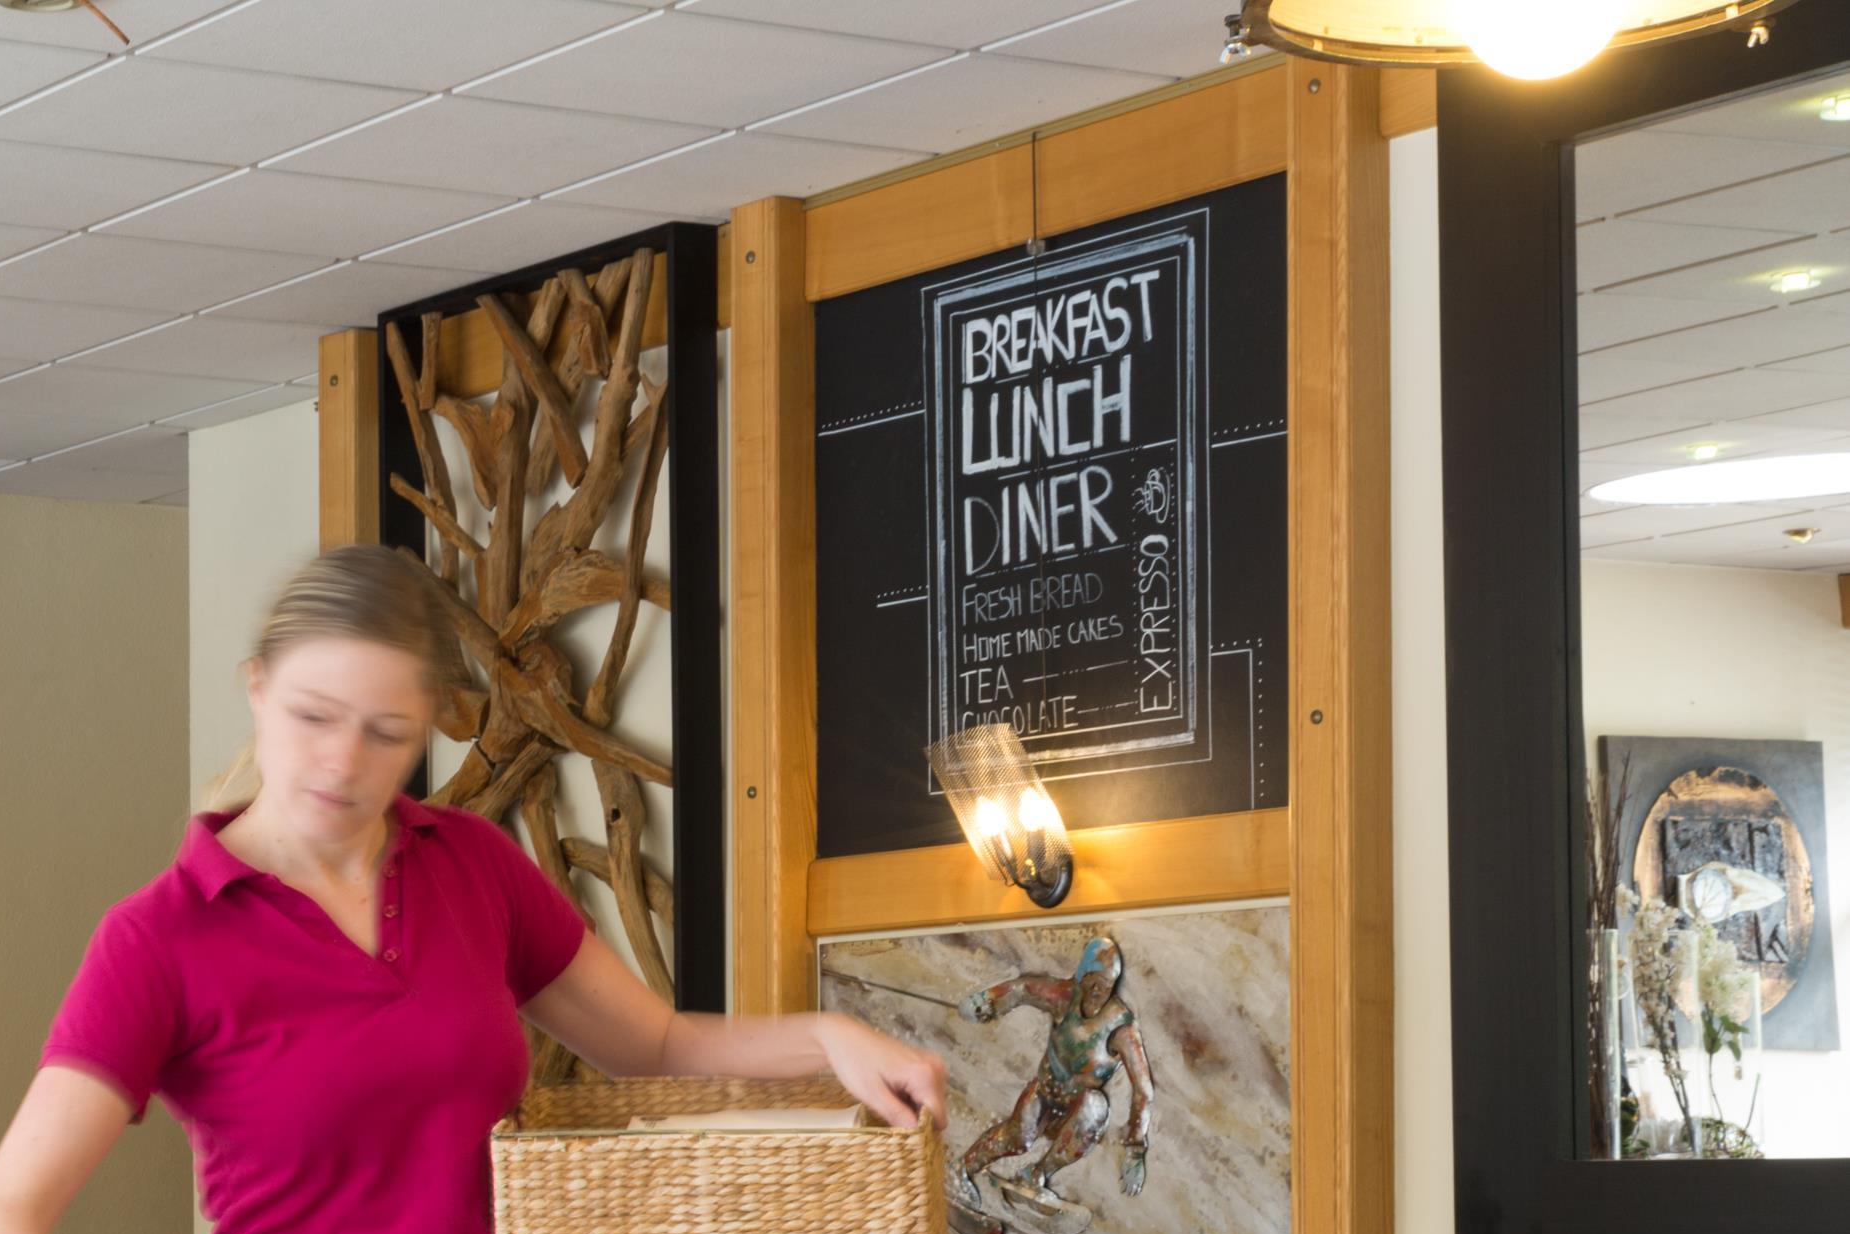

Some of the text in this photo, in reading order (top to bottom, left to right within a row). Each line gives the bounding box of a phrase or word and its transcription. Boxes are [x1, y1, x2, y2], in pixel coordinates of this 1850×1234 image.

[962, 269, 1160, 384] BREAKFAST
[962, 354, 1132, 475] LUNCH
[964, 465, 1118, 576] DINER
[962, 573, 1103, 626] FRESH BREAD
[963, 615, 1124, 664] HOME MADE CAKES
[1138, 534, 1173, 713] EXPRESSO
[960, 665, 1014, 705] TEA
